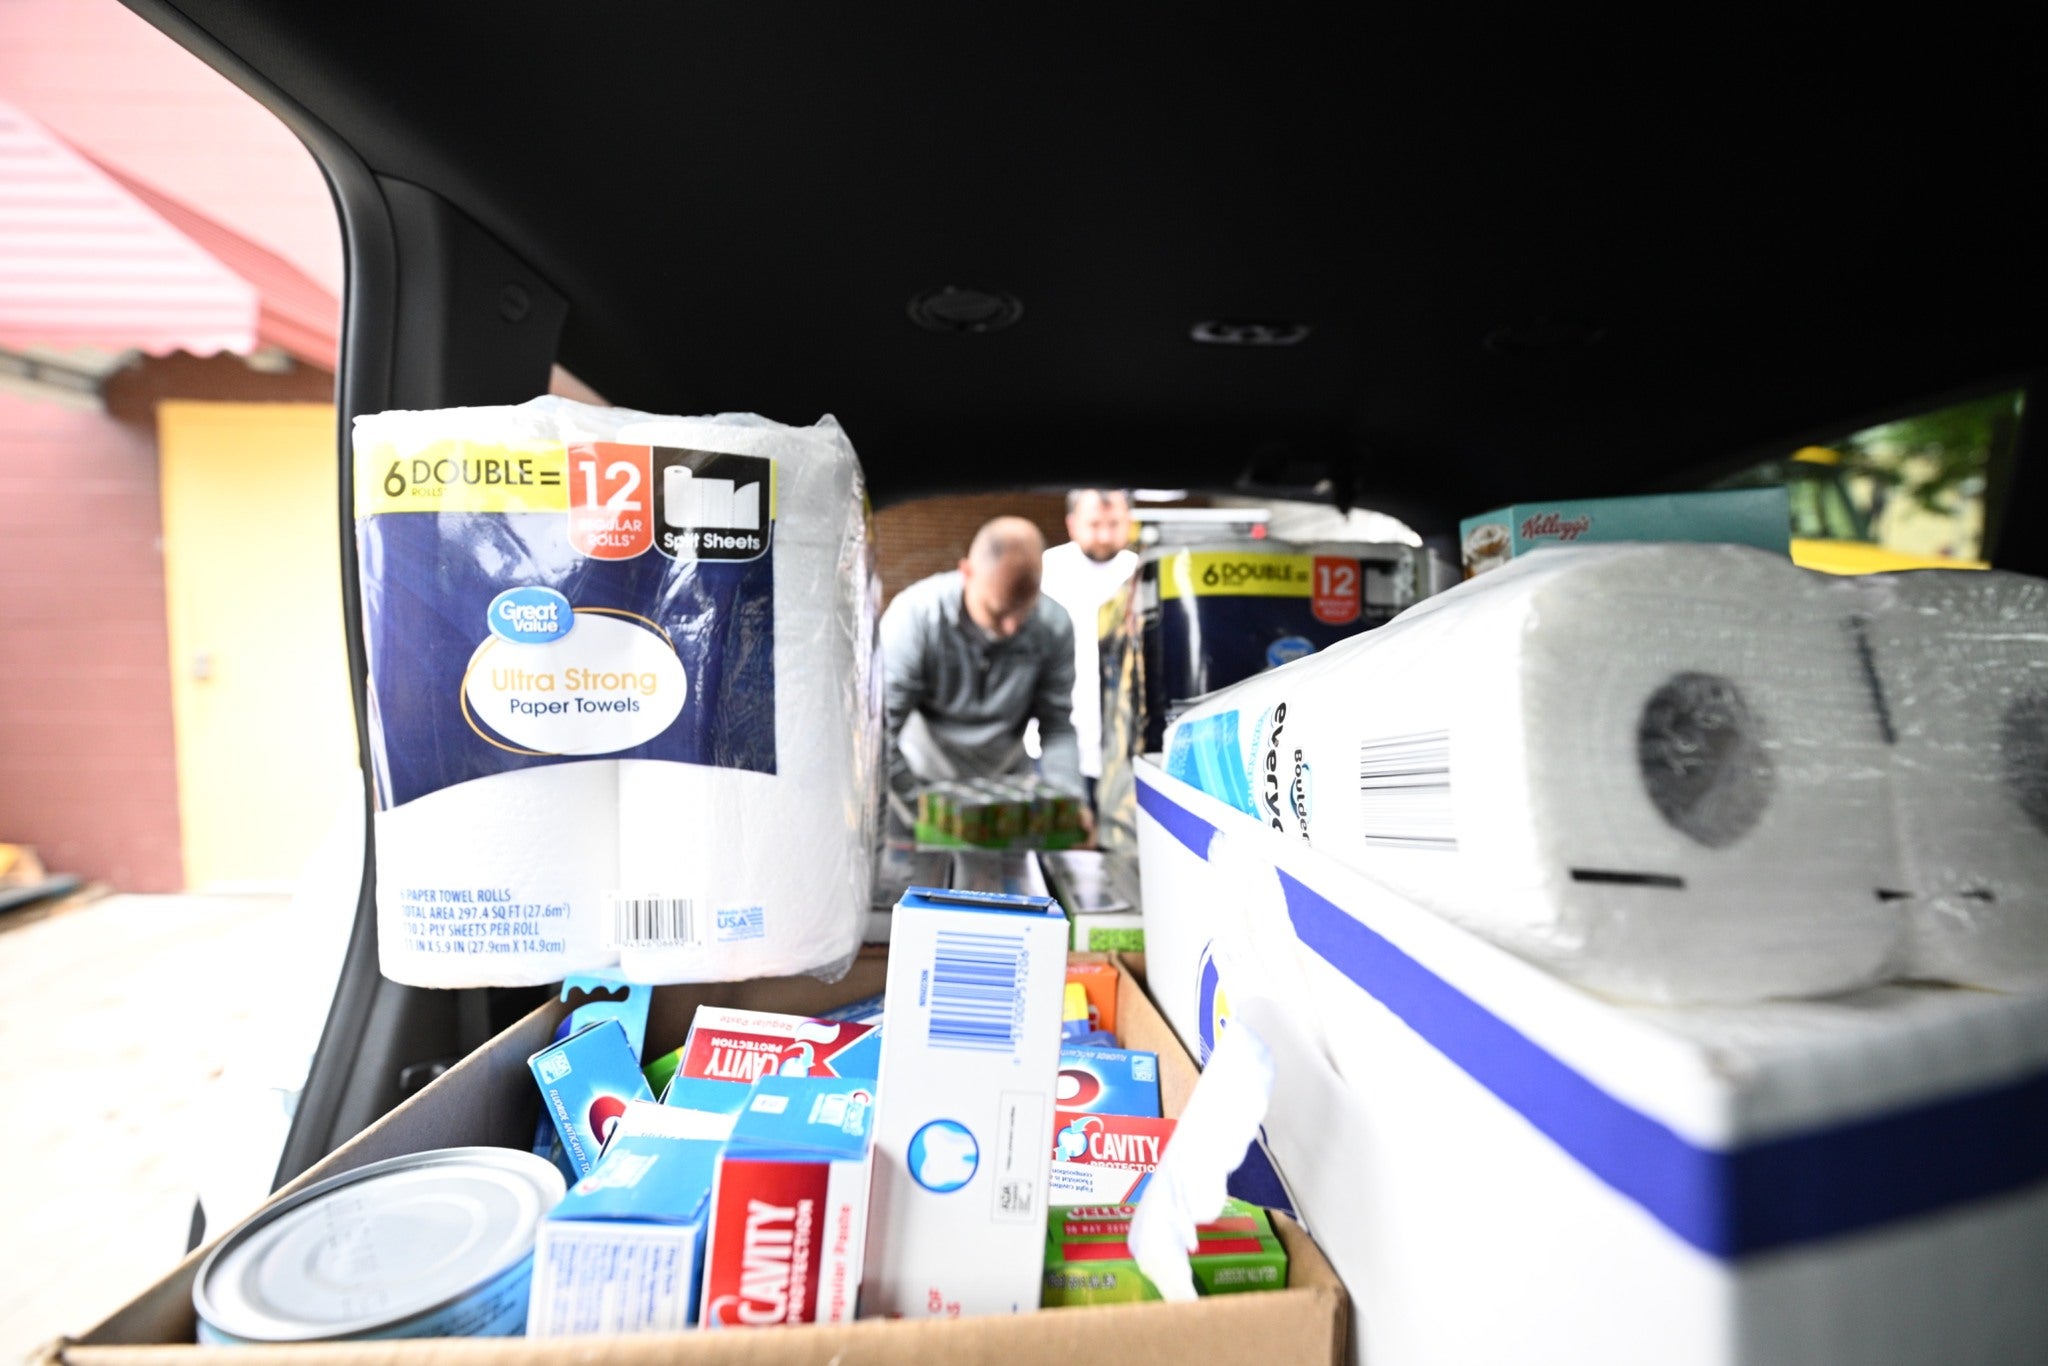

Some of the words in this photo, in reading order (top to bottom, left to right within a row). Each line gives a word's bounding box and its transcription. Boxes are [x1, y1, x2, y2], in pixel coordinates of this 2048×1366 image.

[384, 461, 406, 497] 6
[412, 459, 533, 485] DOUBLE
[578, 461, 641, 511] 12
[578, 518, 641, 531] GULAR
[703, 532, 760, 550] Sheets
[1203, 564, 1219, 586] 6
[1221, 562, 1291, 582] DOUBLE
[1318, 564, 1355, 597] 12
[498, 600, 558, 621] Great
[513, 618, 558, 633] Value
[491, 669, 555, 692] Ultra
[565, 668, 657, 696] Strong
[510, 698, 569, 717] Paper
[575, 697, 640, 713] Towels
[1294, 749, 1311, 842] Boulder
[407, 888, 436, 902] PAPER
[439, 889, 474, 903] TOWEL
[477, 888, 511, 902] ROLLS
[430, 906, 455, 919] AREA
[458, 906, 489, 920] 297.4
[492, 905, 506, 920] SQ
[509, 905, 521, 918] FT
[717, 916, 748, 929] USA
[450, 923, 487, 937] SHEETS
[490, 922, 510, 936] PER
[513, 922, 540, 935] ROLL
[454, 940, 465, 953] IN
[513, 940, 520, 952] X
[711, 1037, 783, 1054] PROTECTION
[704, 1047, 779, 1079] CAVITY
[549, 1088, 570, 1122] FLUORIDE
[563, 1121, 587, 1162] ANTICAVITY
[1089, 1132, 1160, 1164] CAVITY
[737, 1199, 796, 1324] CAVITY
[829, 1261, 846, 1322] egular
